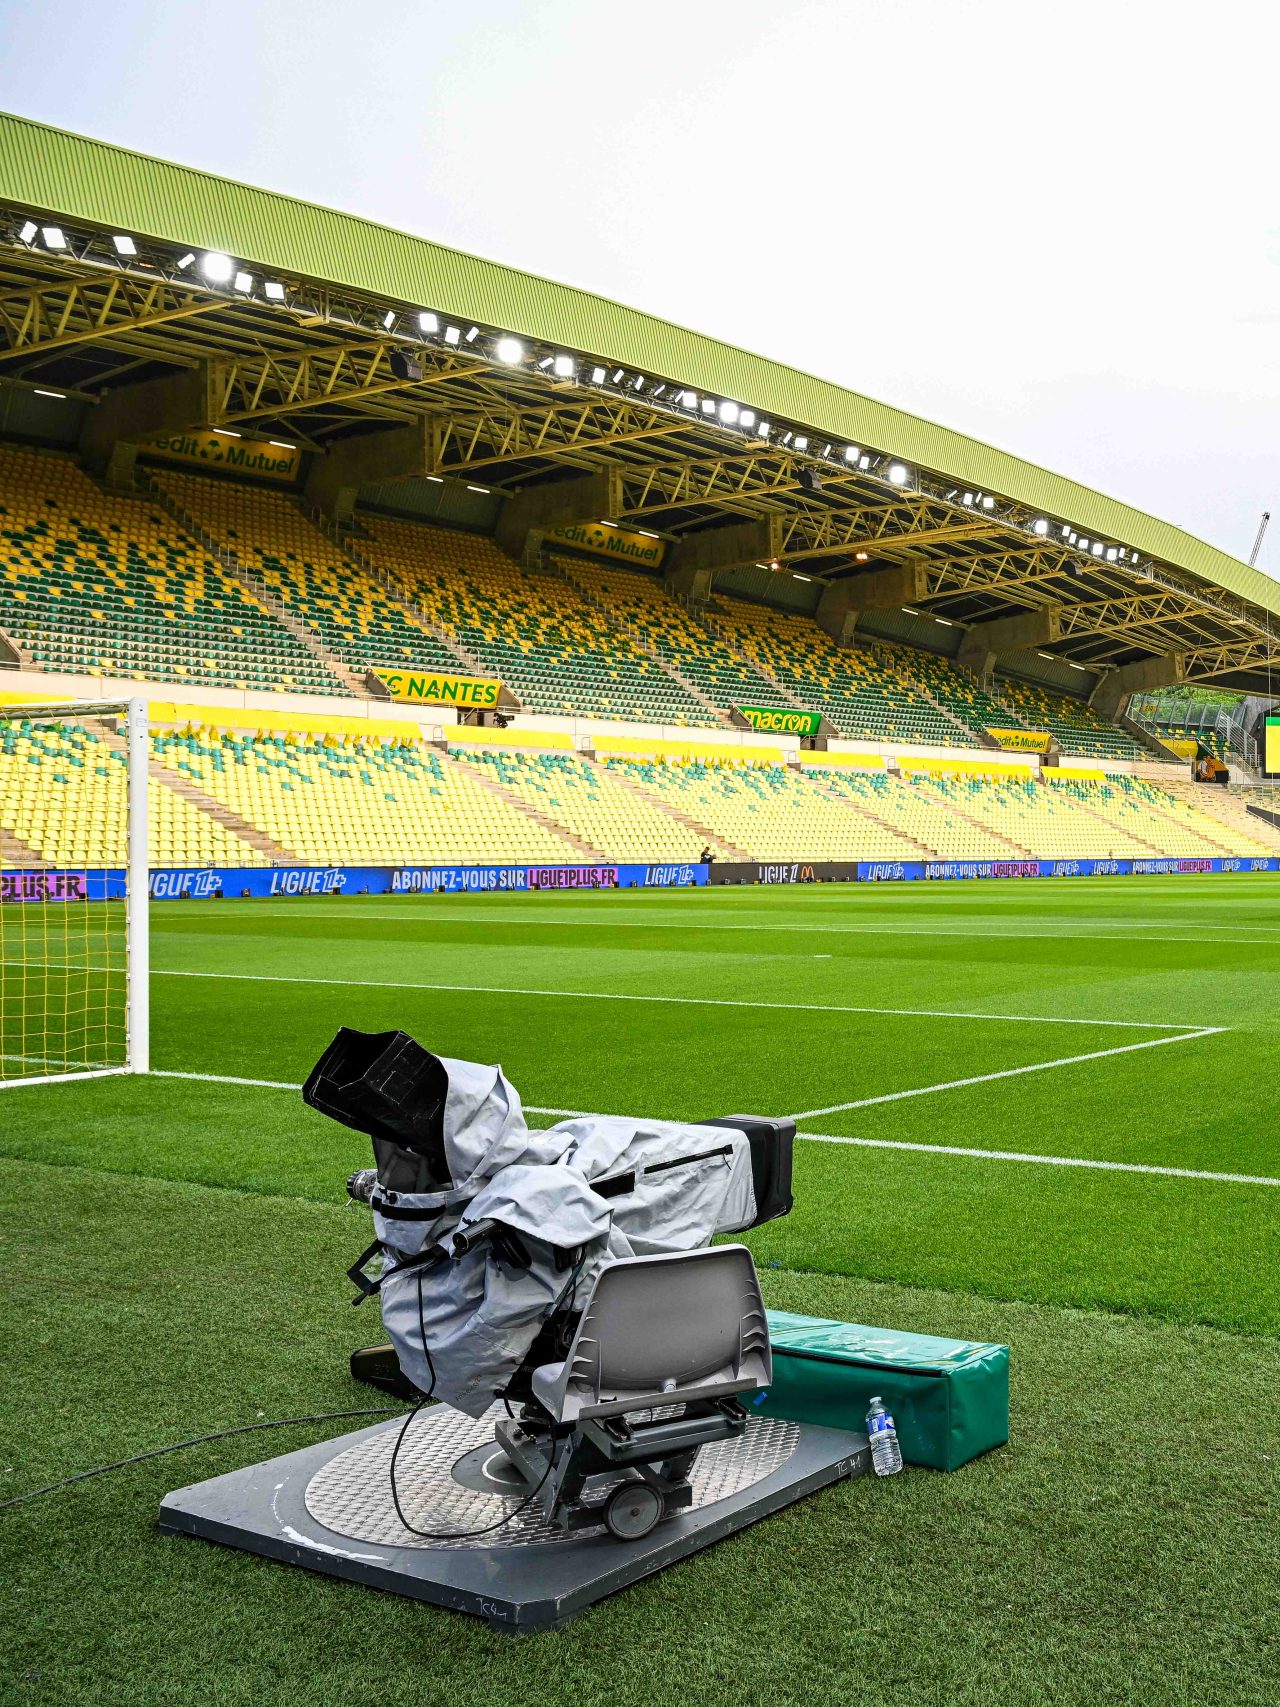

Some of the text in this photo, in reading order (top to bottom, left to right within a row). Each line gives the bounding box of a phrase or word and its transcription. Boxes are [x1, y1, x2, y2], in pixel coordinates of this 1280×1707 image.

[225, 445, 295, 474] Mutuel
[606, 535, 659, 561] Mutuel
[407, 676, 497, 704] NANTES
[392, 867, 616, 890] ABONNEZ-VOUS SUR LIGUE1PLUS.FR
